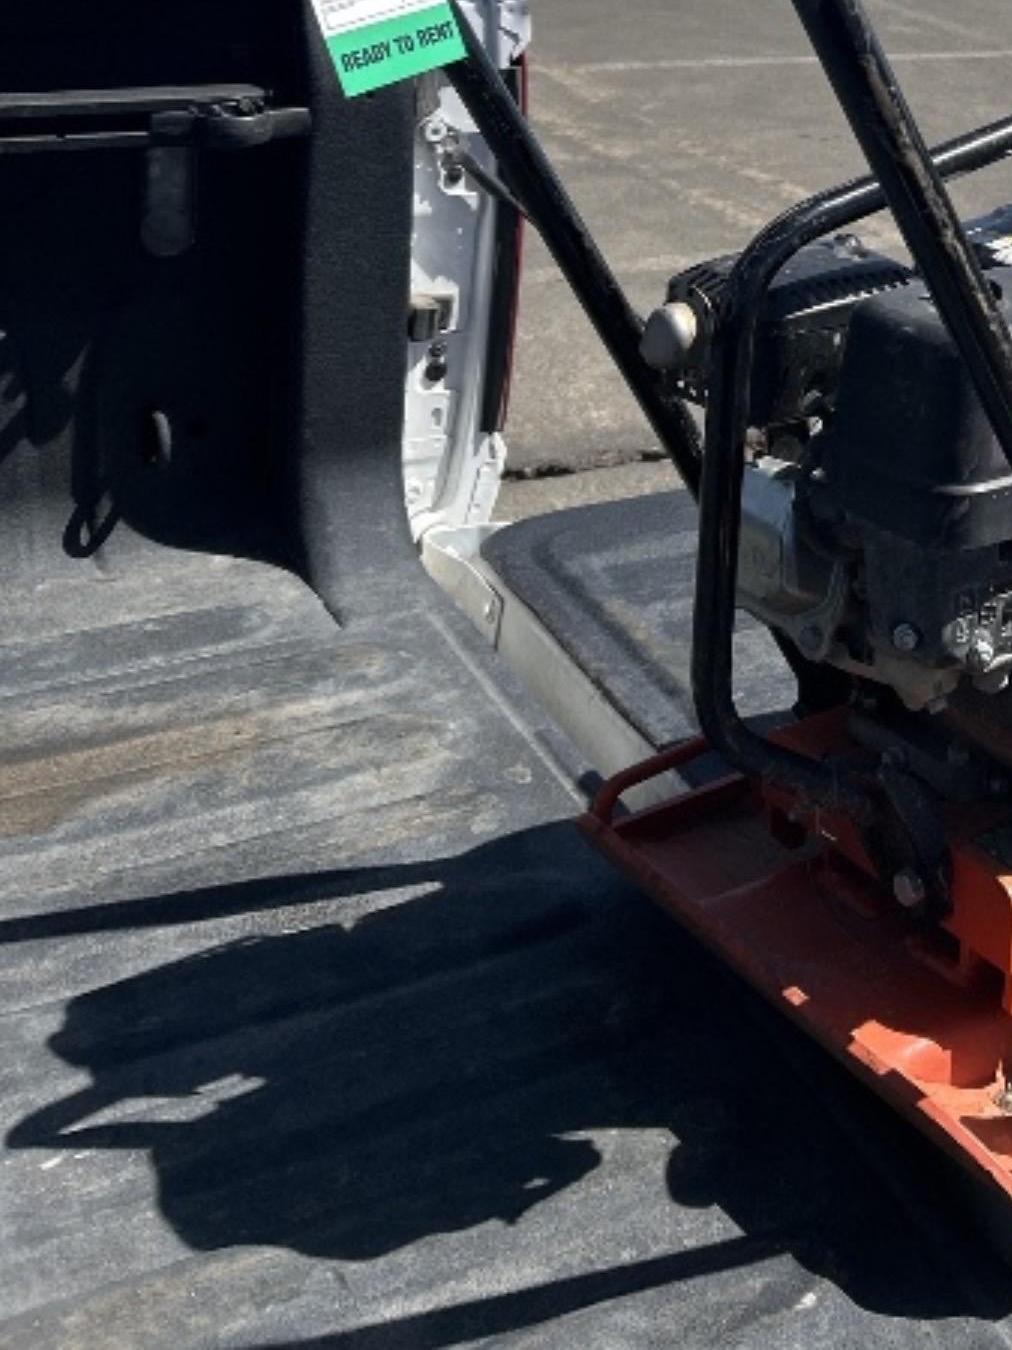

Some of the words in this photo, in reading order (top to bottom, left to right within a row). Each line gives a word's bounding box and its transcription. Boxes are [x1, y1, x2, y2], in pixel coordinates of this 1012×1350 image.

[341, 39, 392, 73] READY
[391, 33, 416, 55] TO
[416, 20, 454, 49] RENT
